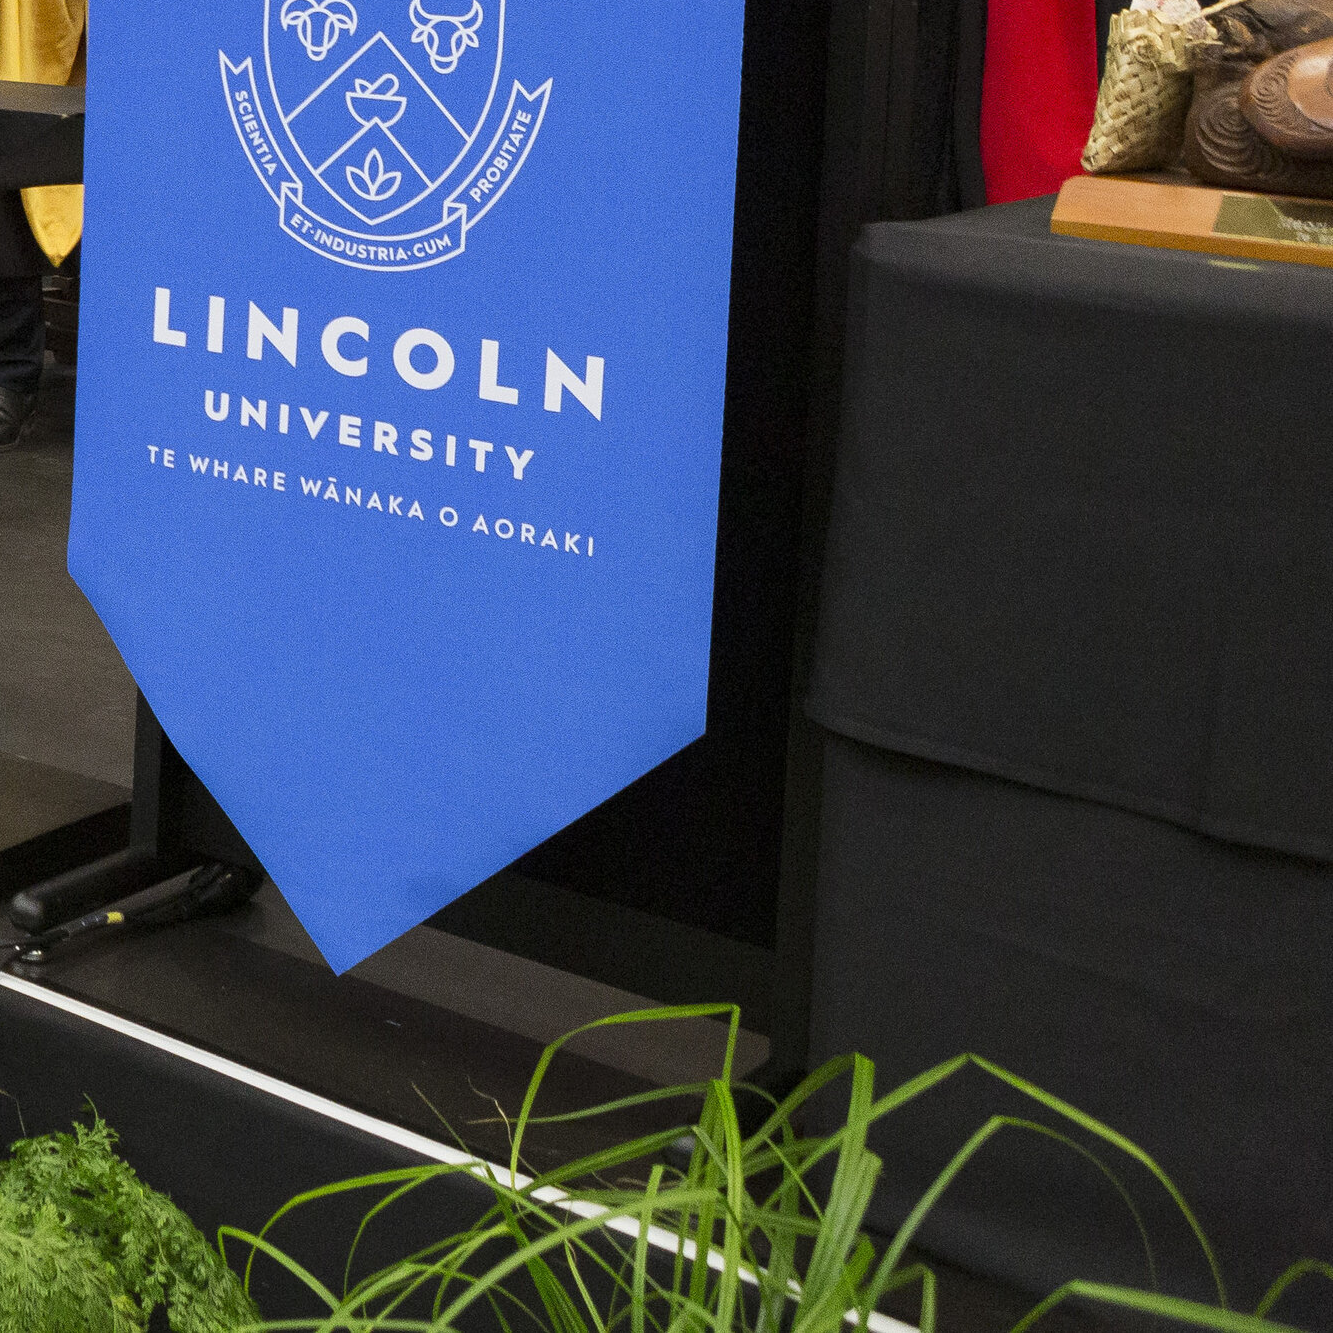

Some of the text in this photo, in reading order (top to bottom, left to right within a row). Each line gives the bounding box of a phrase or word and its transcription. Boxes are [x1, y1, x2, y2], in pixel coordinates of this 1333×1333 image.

[234, 89, 277, 176] SCIENTIA
[469, 108, 532, 202] PROBITATE
[152, 287, 605, 422] LINCOLN
[204, 389, 536, 481] UNIVERSITY
[147, 445, 596, 557] TE WHARE WĀNAKA O AORAKI
